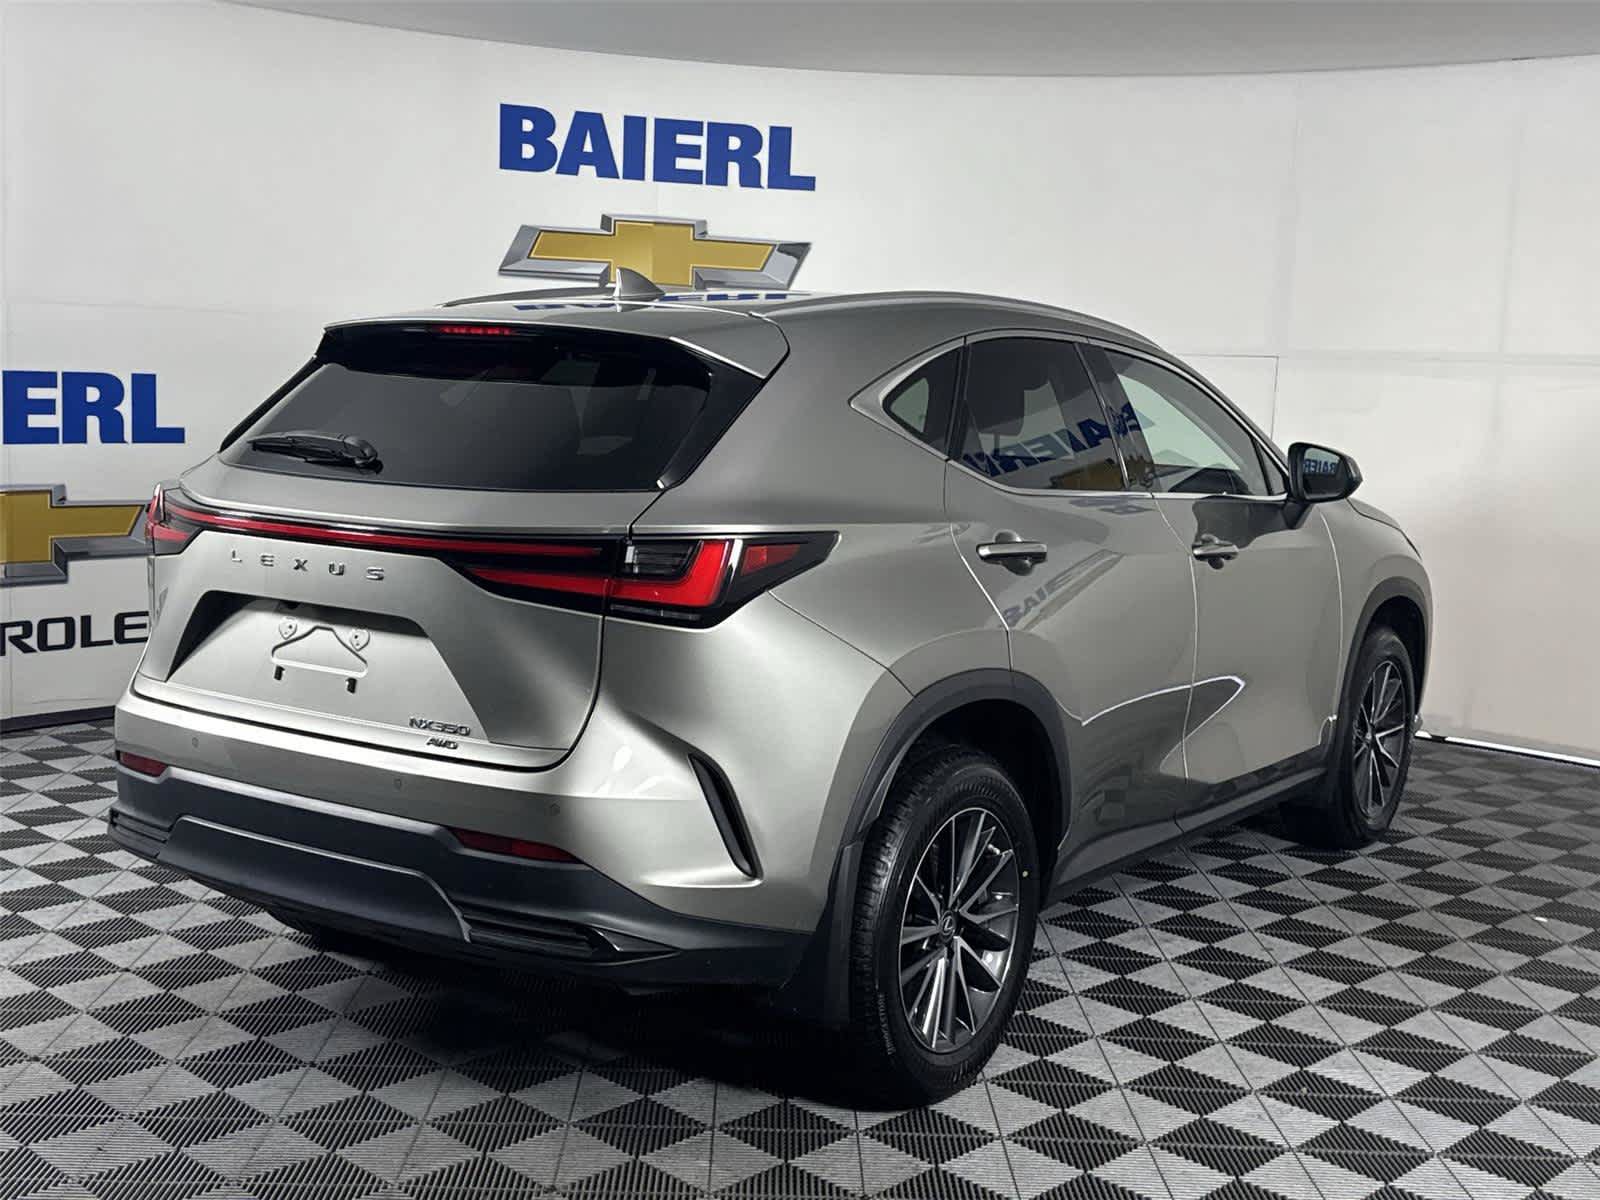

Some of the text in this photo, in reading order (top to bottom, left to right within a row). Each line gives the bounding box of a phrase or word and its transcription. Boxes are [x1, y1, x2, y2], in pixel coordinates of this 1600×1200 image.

[499, 103, 816, 191] BAIERL
[231, 550, 385, 581] LEXUS
[408, 717, 471, 737] NX350
[426, 738, 458, 750] AWD
